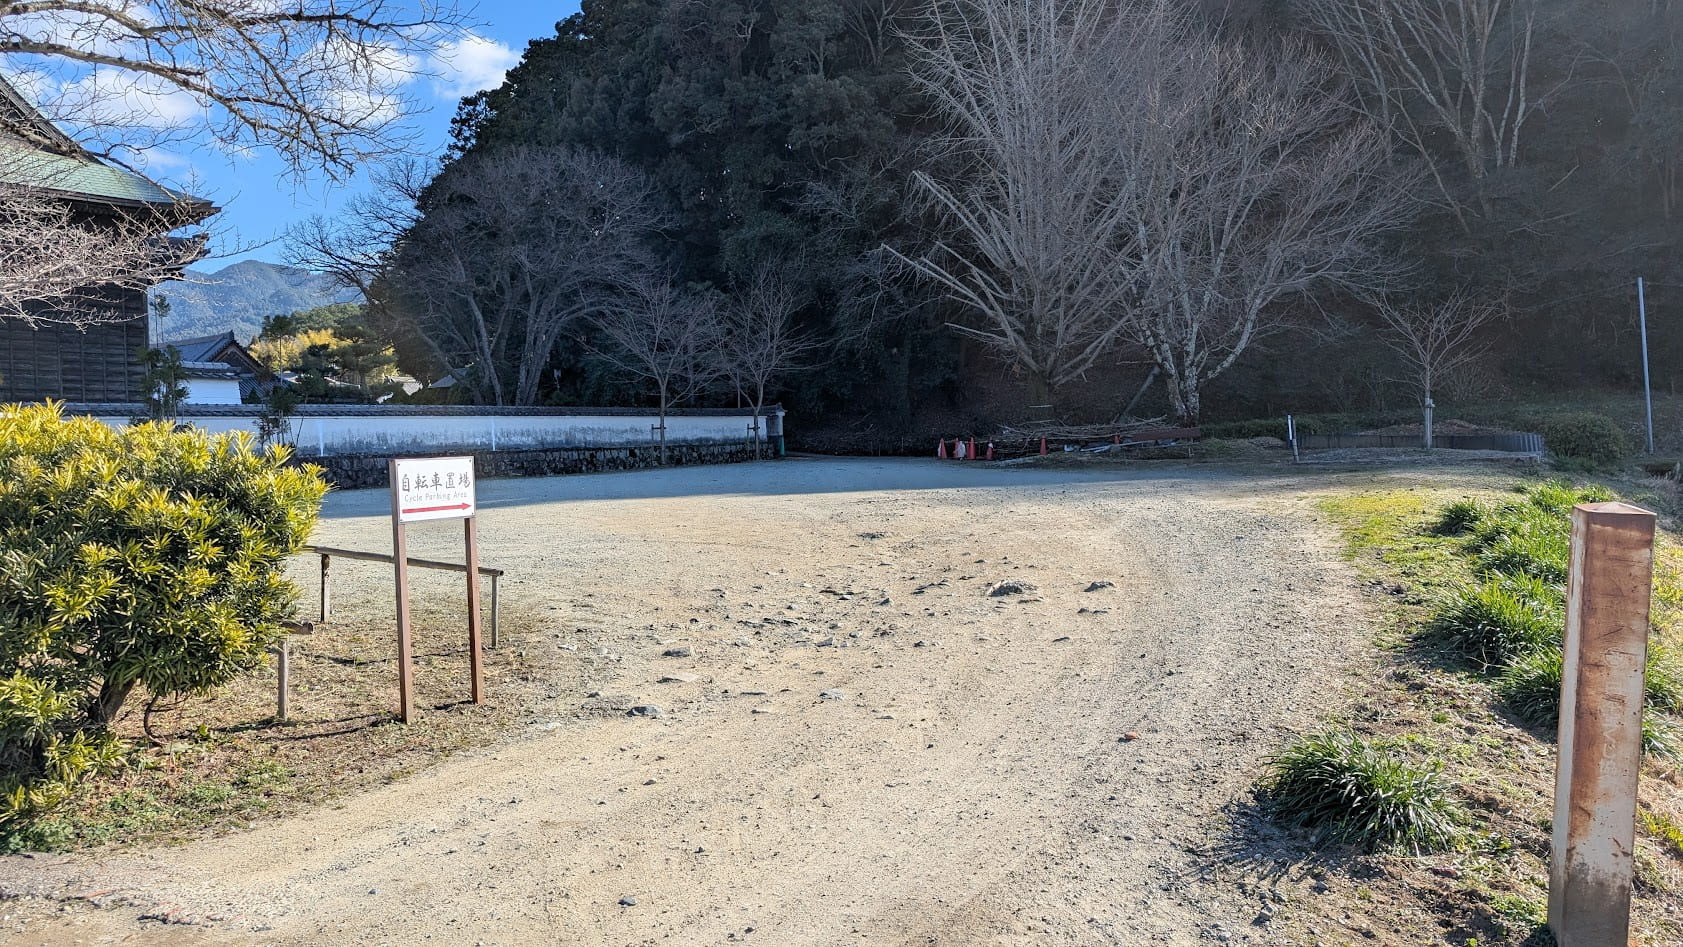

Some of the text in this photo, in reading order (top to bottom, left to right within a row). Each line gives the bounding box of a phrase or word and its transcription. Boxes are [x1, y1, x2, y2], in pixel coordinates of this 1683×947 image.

[402, 472, 471, 492] 自転車置場
[404, 491, 468, 503] Cycle Parking Area
